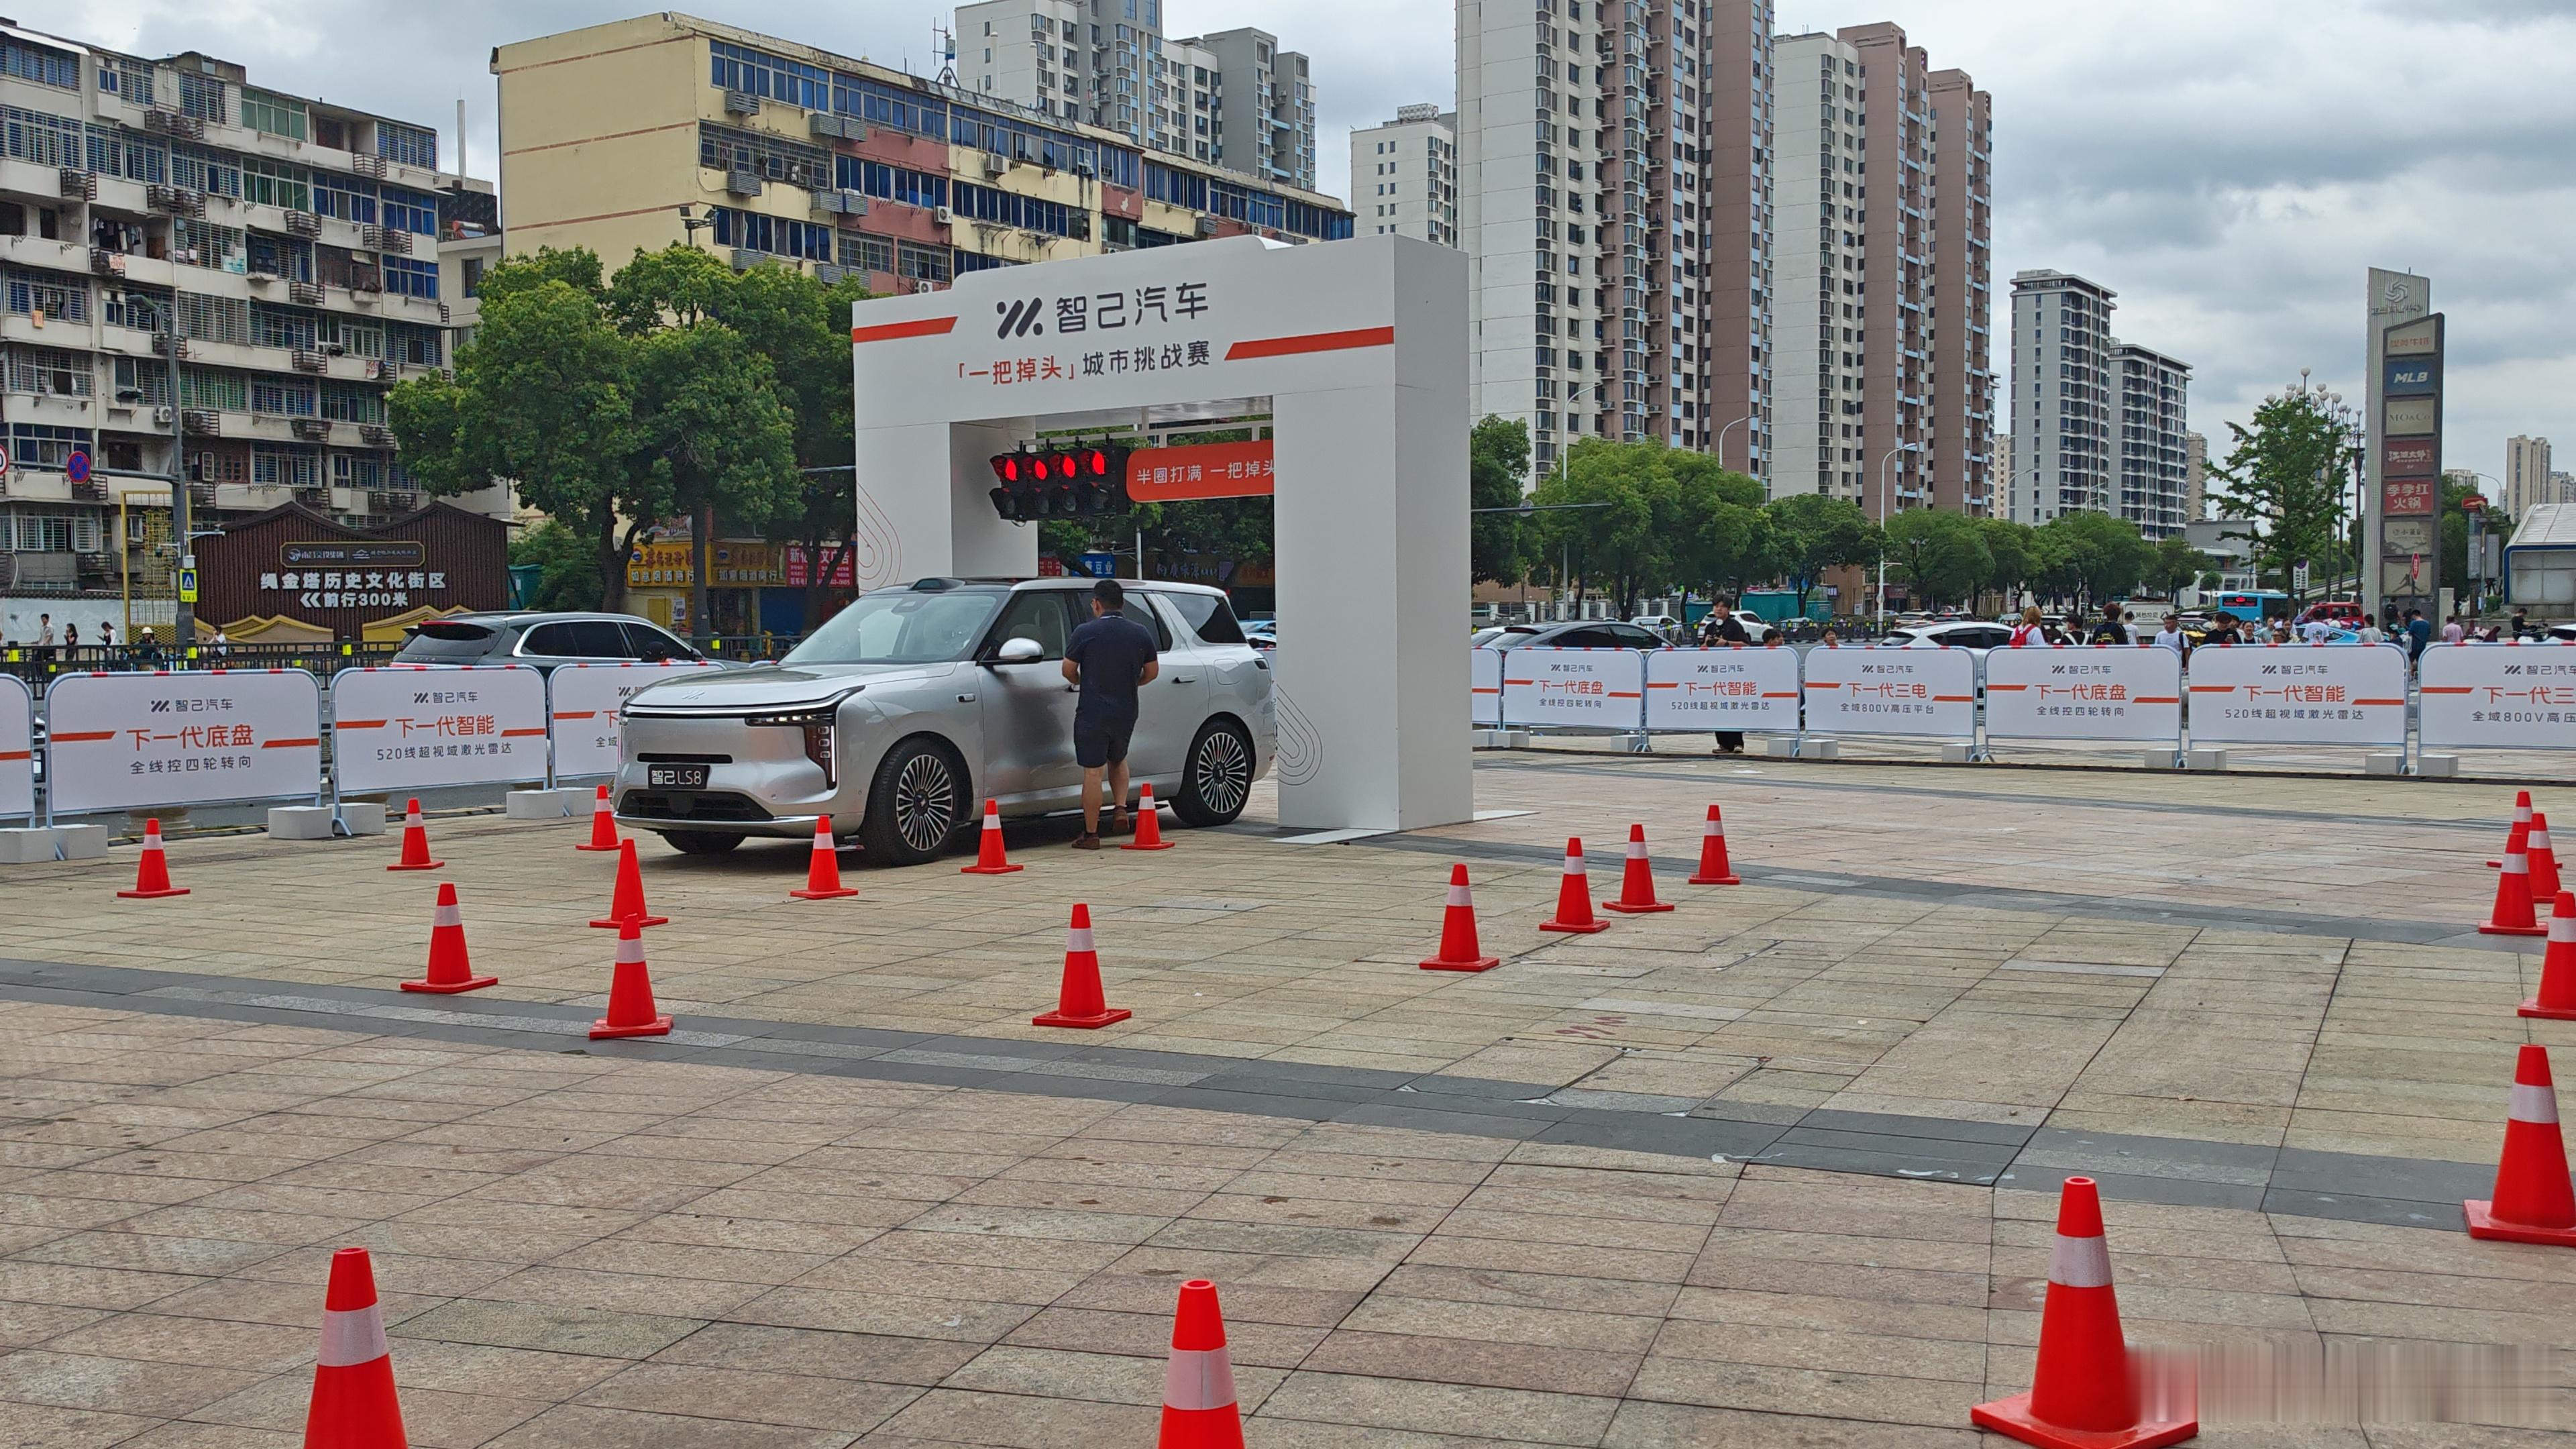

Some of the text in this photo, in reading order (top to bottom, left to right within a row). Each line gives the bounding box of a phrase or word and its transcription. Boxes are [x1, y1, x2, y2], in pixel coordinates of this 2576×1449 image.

[1056, 282, 1209, 333] 智己汽车
[2394, 372, 2428, 383] MLB
[1136, 459, 1275, 485] 半圈打满 一把掉头
[2387, 484, 2429, 496] 季季红
[2394, 497, 2421, 508] 火锅
[260, 572, 446, 590] 绳金塔历史文化街区
[324, 592, 409, 608] 前行300米
[1563, 664, 1593, 672] 智己汽车
[1711, 664, 1745, 673] 智己汽车
[1876, 665, 1914, 674] 智己汽车
[2069, 665, 2112, 674] 智己汽车
[2281, 665, 2328, 675] 智己汽车
[1538, 680, 1603, 694] 下一代底盘
[1684, 681, 1757, 696] 下一代智能
[1847, 682, 1927, 698] 下一代三电
[2034, 684, 2127, 700] 下一代底盘
[2243, 685, 2346, 702] 下一代智能
[175, 698, 233, 712] 智己汽车
[433, 692, 478, 704] 智己汽车
[1539, 698, 1602, 708] 全线控四轮转向
[1671, 701, 1770, 710] 520线超视域激光雷达
[1840, 703, 1934, 714] 全域800V高压平台
[2036, 706, 2125, 716] 全线控四轮转向
[2224, 708, 2364, 720] 520线超视域激光雷达
[395, 714, 495, 738] 下一代智能
[125, 724, 254, 751] 下一代底盘
[377, 742, 513, 761] 520线超视域激光雷达
[129, 755, 252, 775] 全线控四轮转向
[651, 770, 702, 785] 智己LS8
